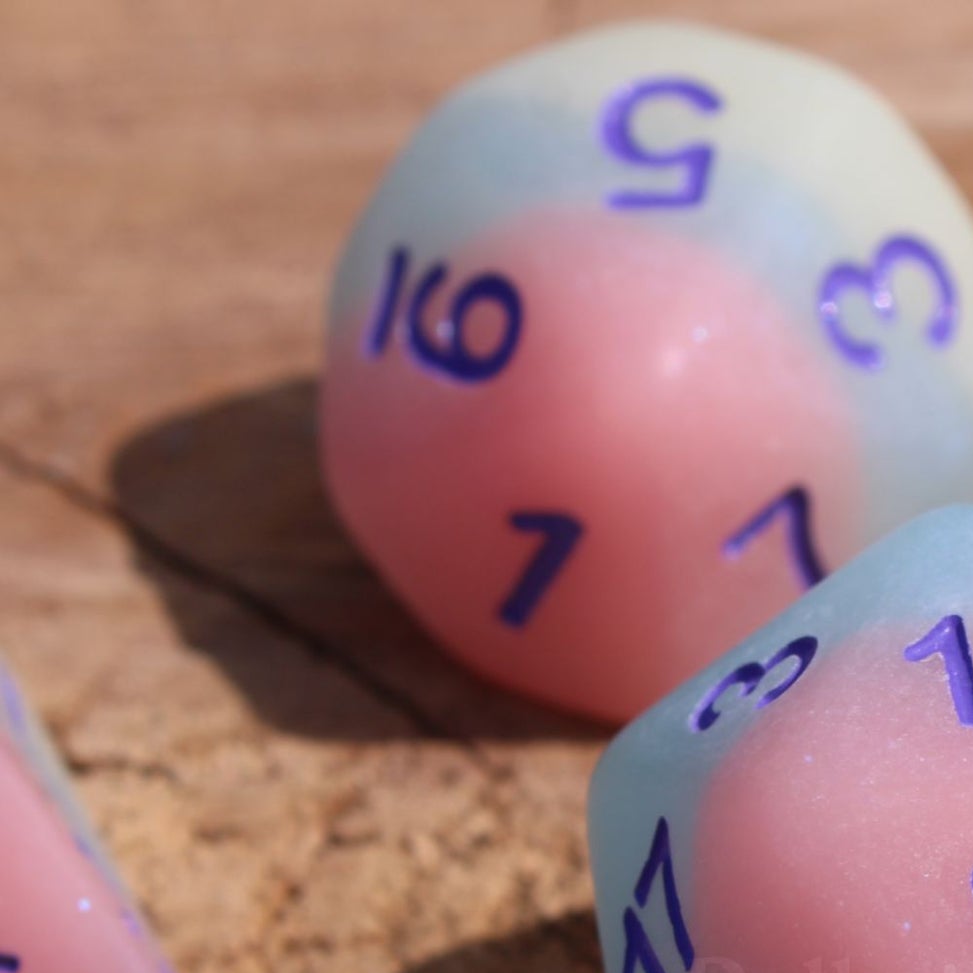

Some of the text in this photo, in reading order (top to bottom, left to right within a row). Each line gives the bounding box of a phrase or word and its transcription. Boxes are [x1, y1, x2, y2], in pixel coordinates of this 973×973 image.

[600, 75, 722, 210] 5
[816, 232, 960, 372] 3
[688, 635, 819, 735] 3
